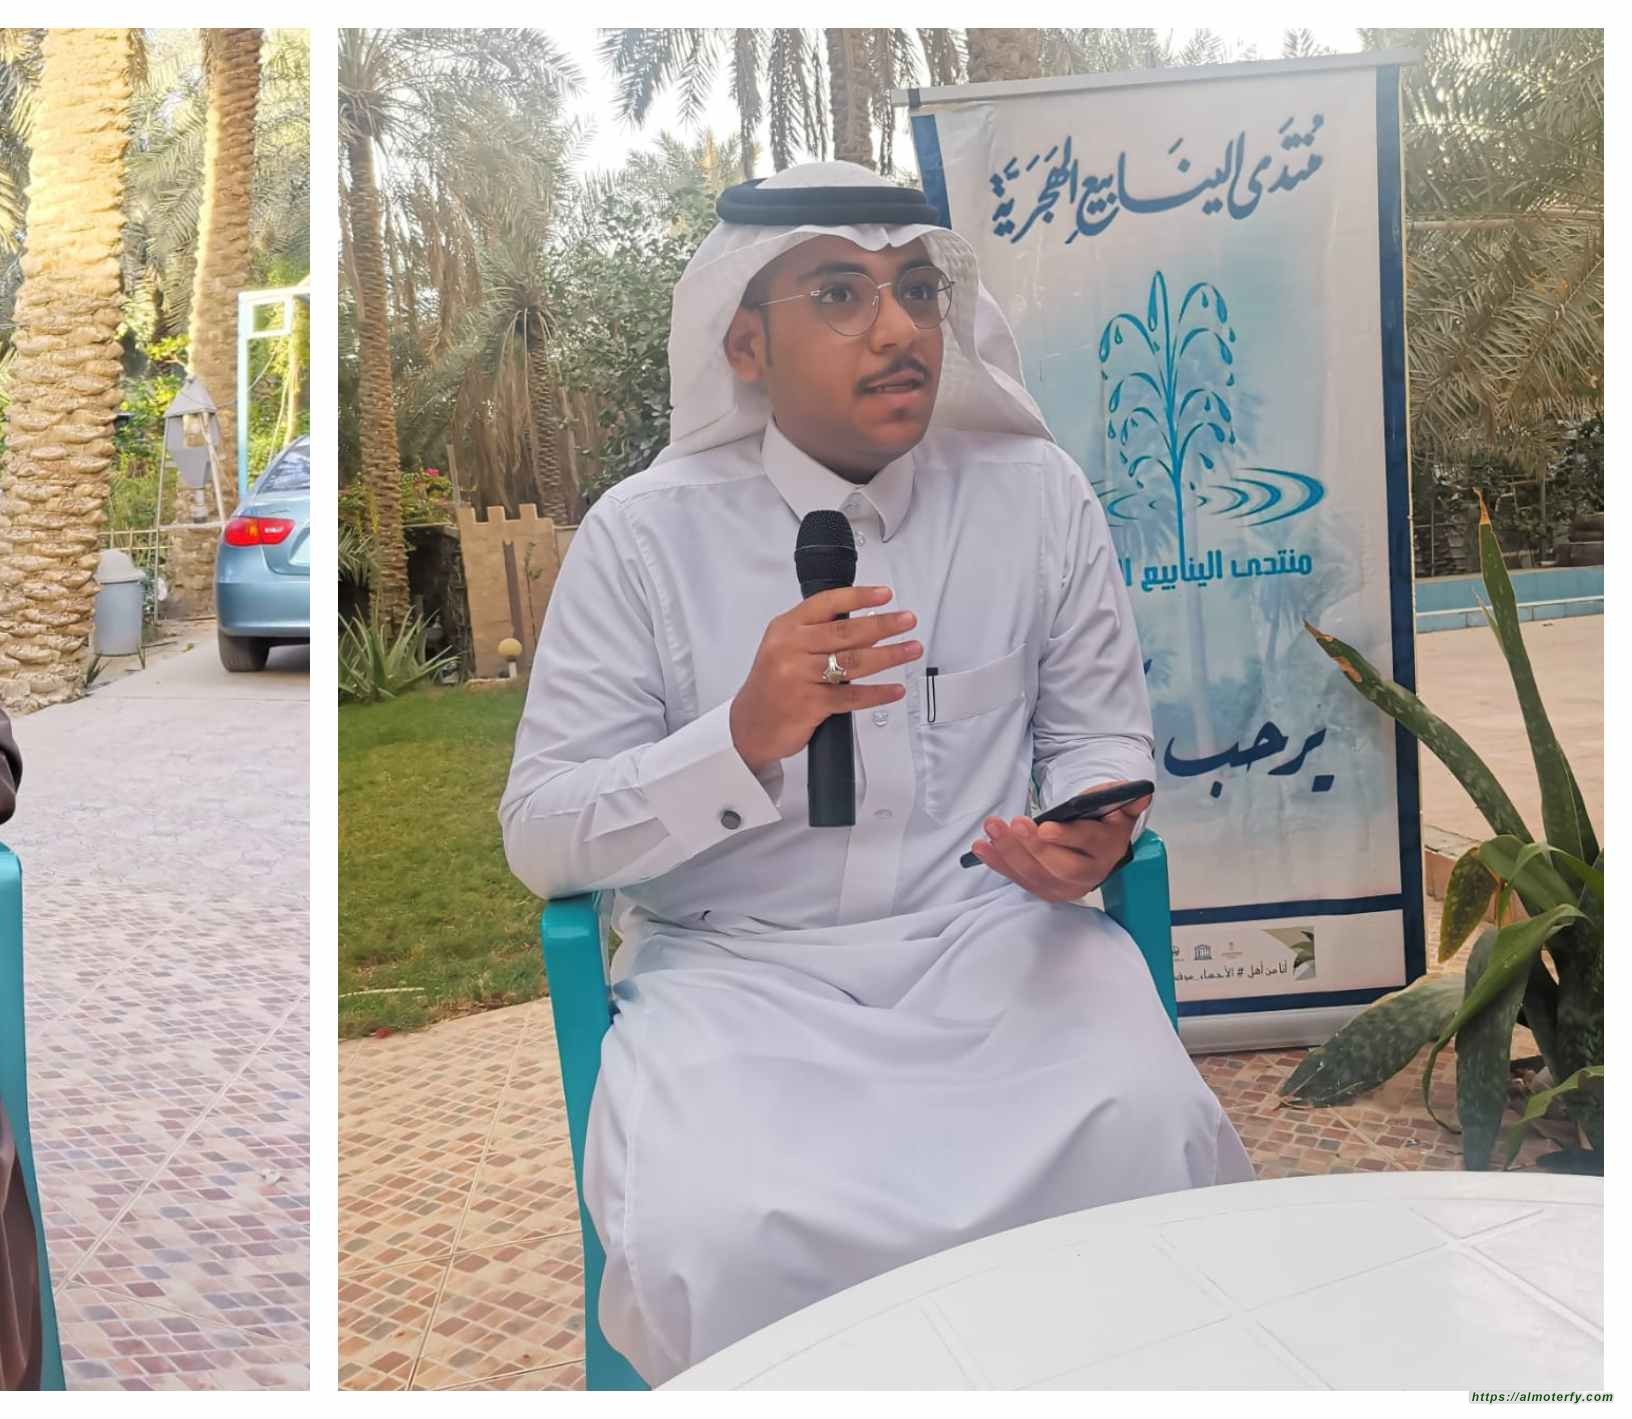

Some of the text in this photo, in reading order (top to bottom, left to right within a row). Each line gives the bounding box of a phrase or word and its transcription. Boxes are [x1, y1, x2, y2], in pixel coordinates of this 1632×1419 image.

[1140, 549, 1223, 592] الينابيع
[1230, 548, 1313, 578] منتدى
[1163, 720, 1335, 799] يرحب
